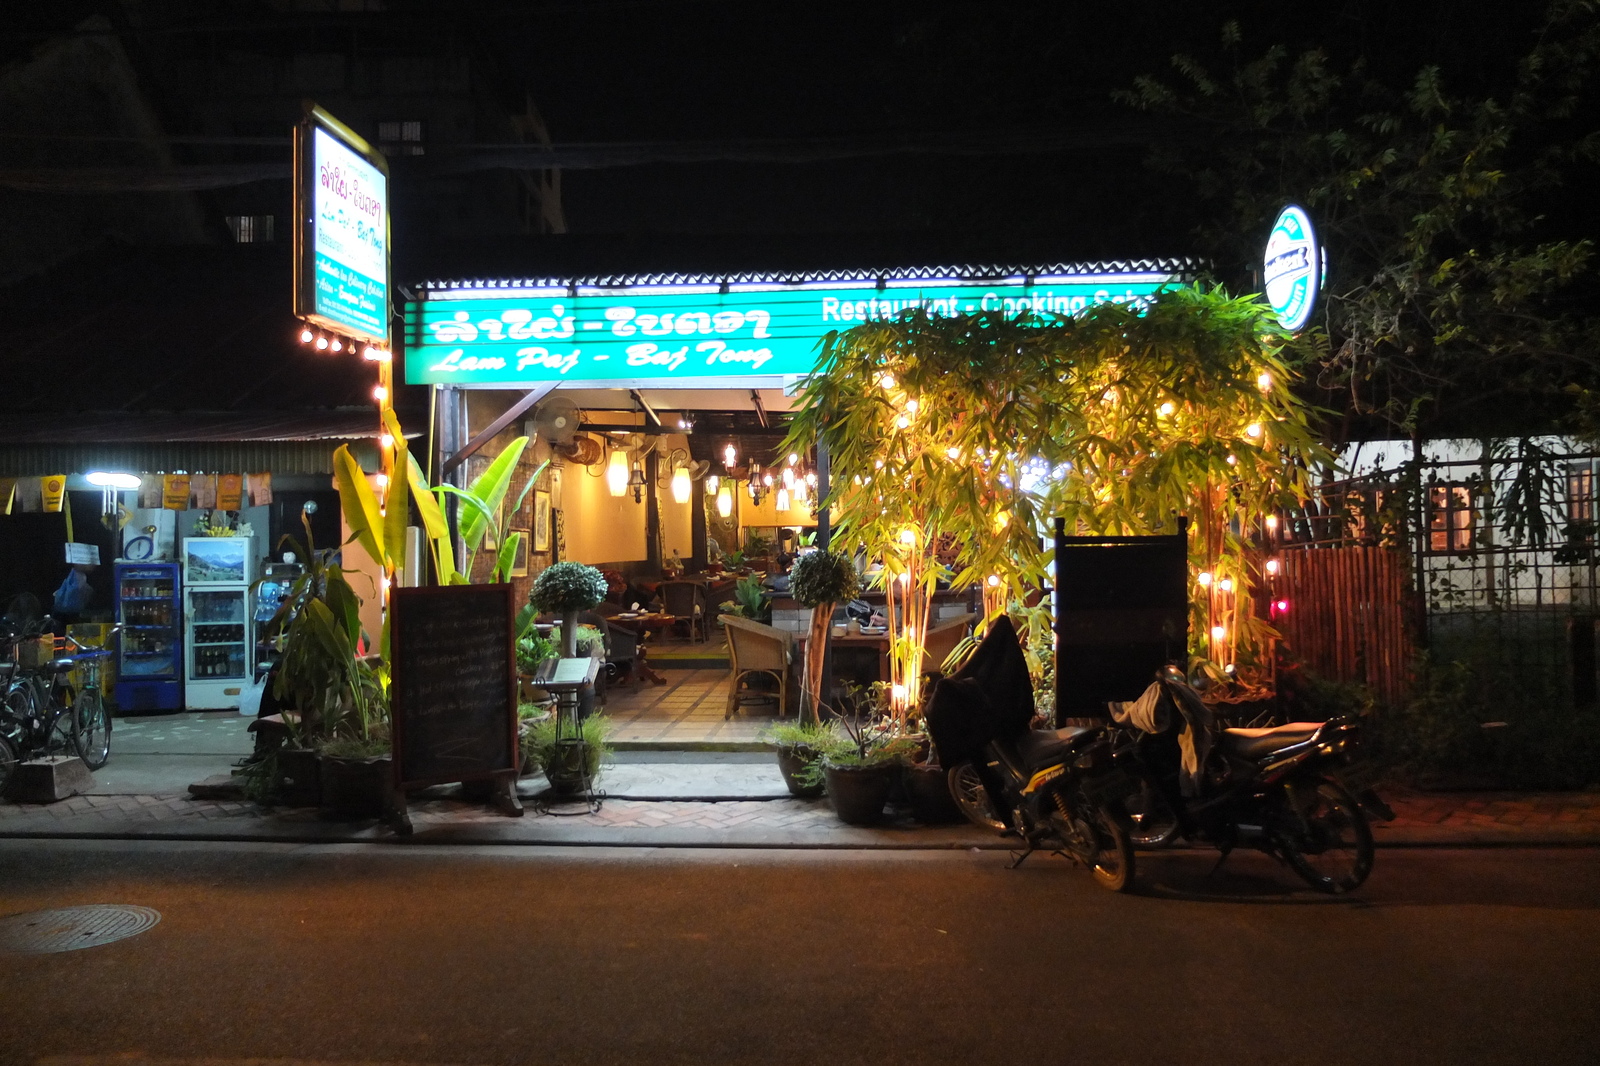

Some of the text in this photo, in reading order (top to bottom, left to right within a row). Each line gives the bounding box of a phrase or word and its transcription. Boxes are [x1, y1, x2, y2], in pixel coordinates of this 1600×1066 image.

[430, 349, 506, 373] Lam
[516, 346, 580, 373] Paj
[625, 343, 689, 372] Baj
[696, 340, 773, 369] Tong
